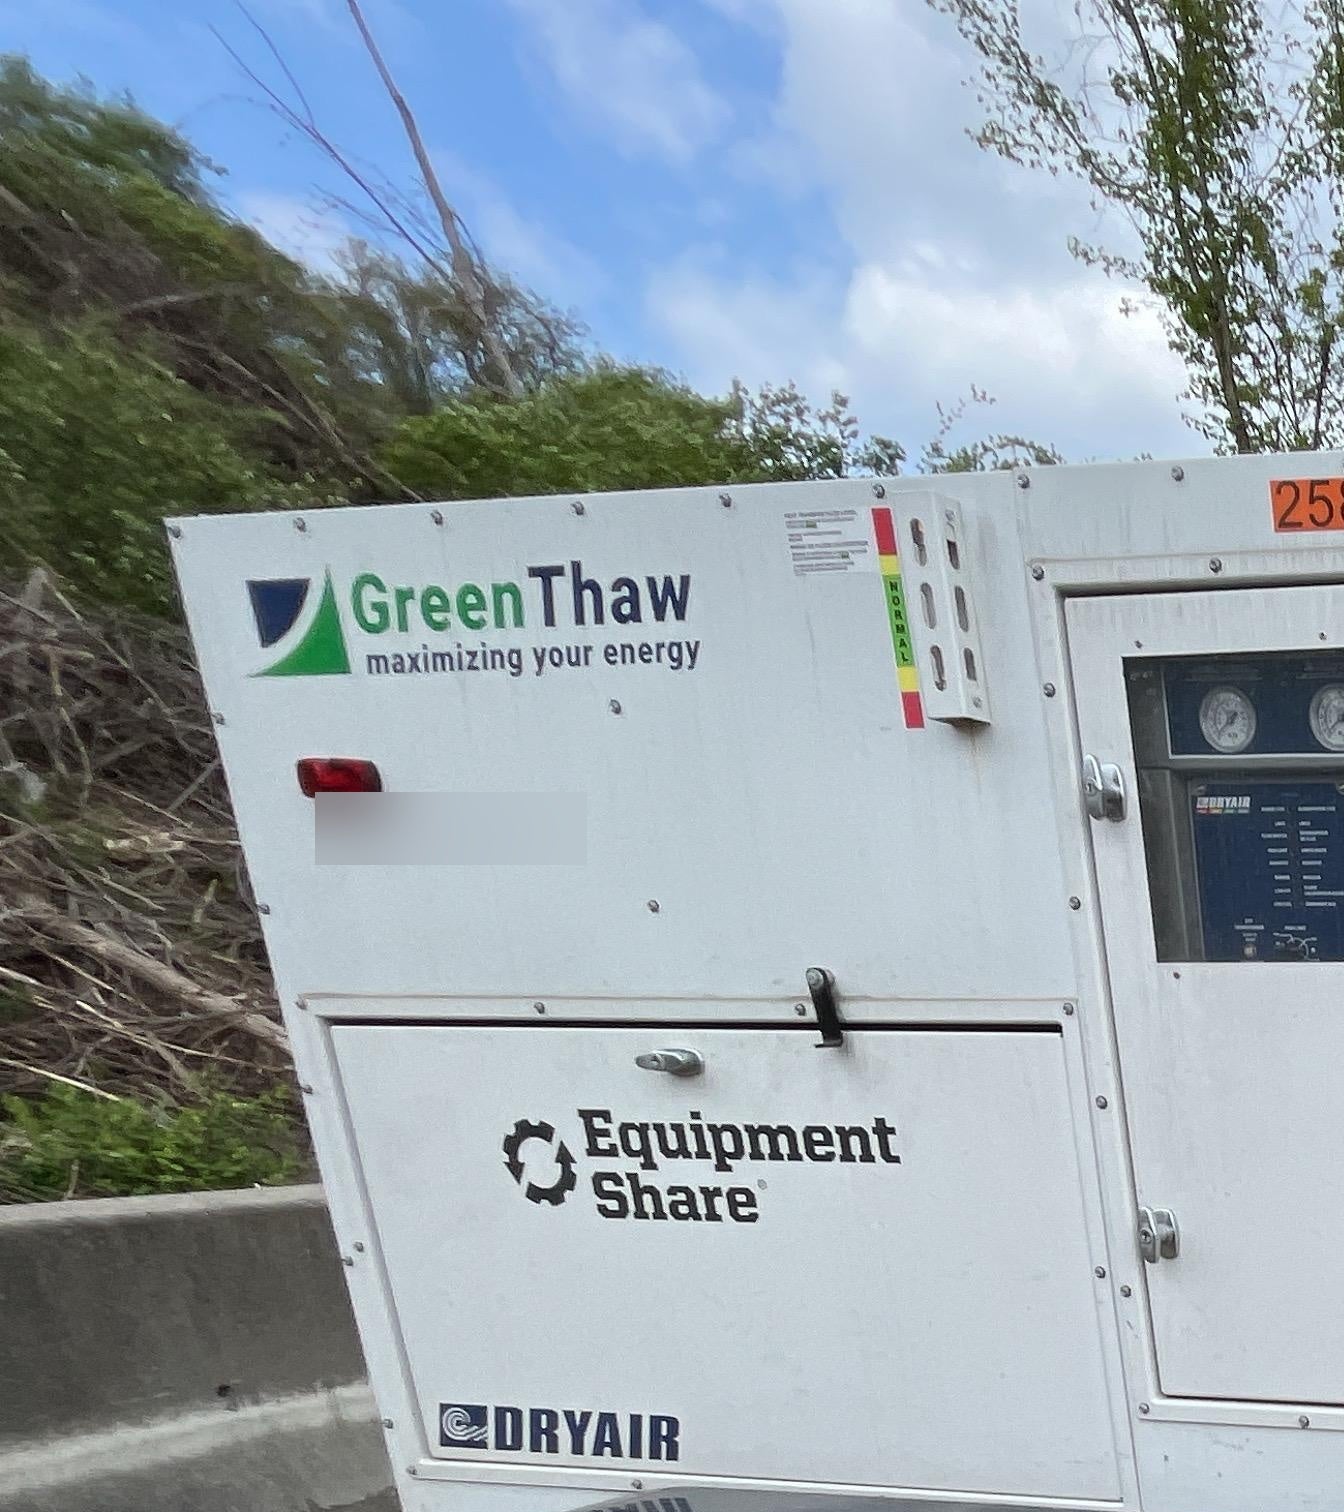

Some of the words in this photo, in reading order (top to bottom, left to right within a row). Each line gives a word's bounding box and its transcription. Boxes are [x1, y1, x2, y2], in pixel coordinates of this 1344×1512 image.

[889, 580, 910, 662] NORMAL
[366, 641, 523, 677] maximizing
[531, 642, 594, 677] your
[603, 639, 701, 671] energy
[578, 1108, 902, 1172] Equipment
[593, 1171, 759, 1223] Share
[494, 1405, 680, 1461] DRYAIR
